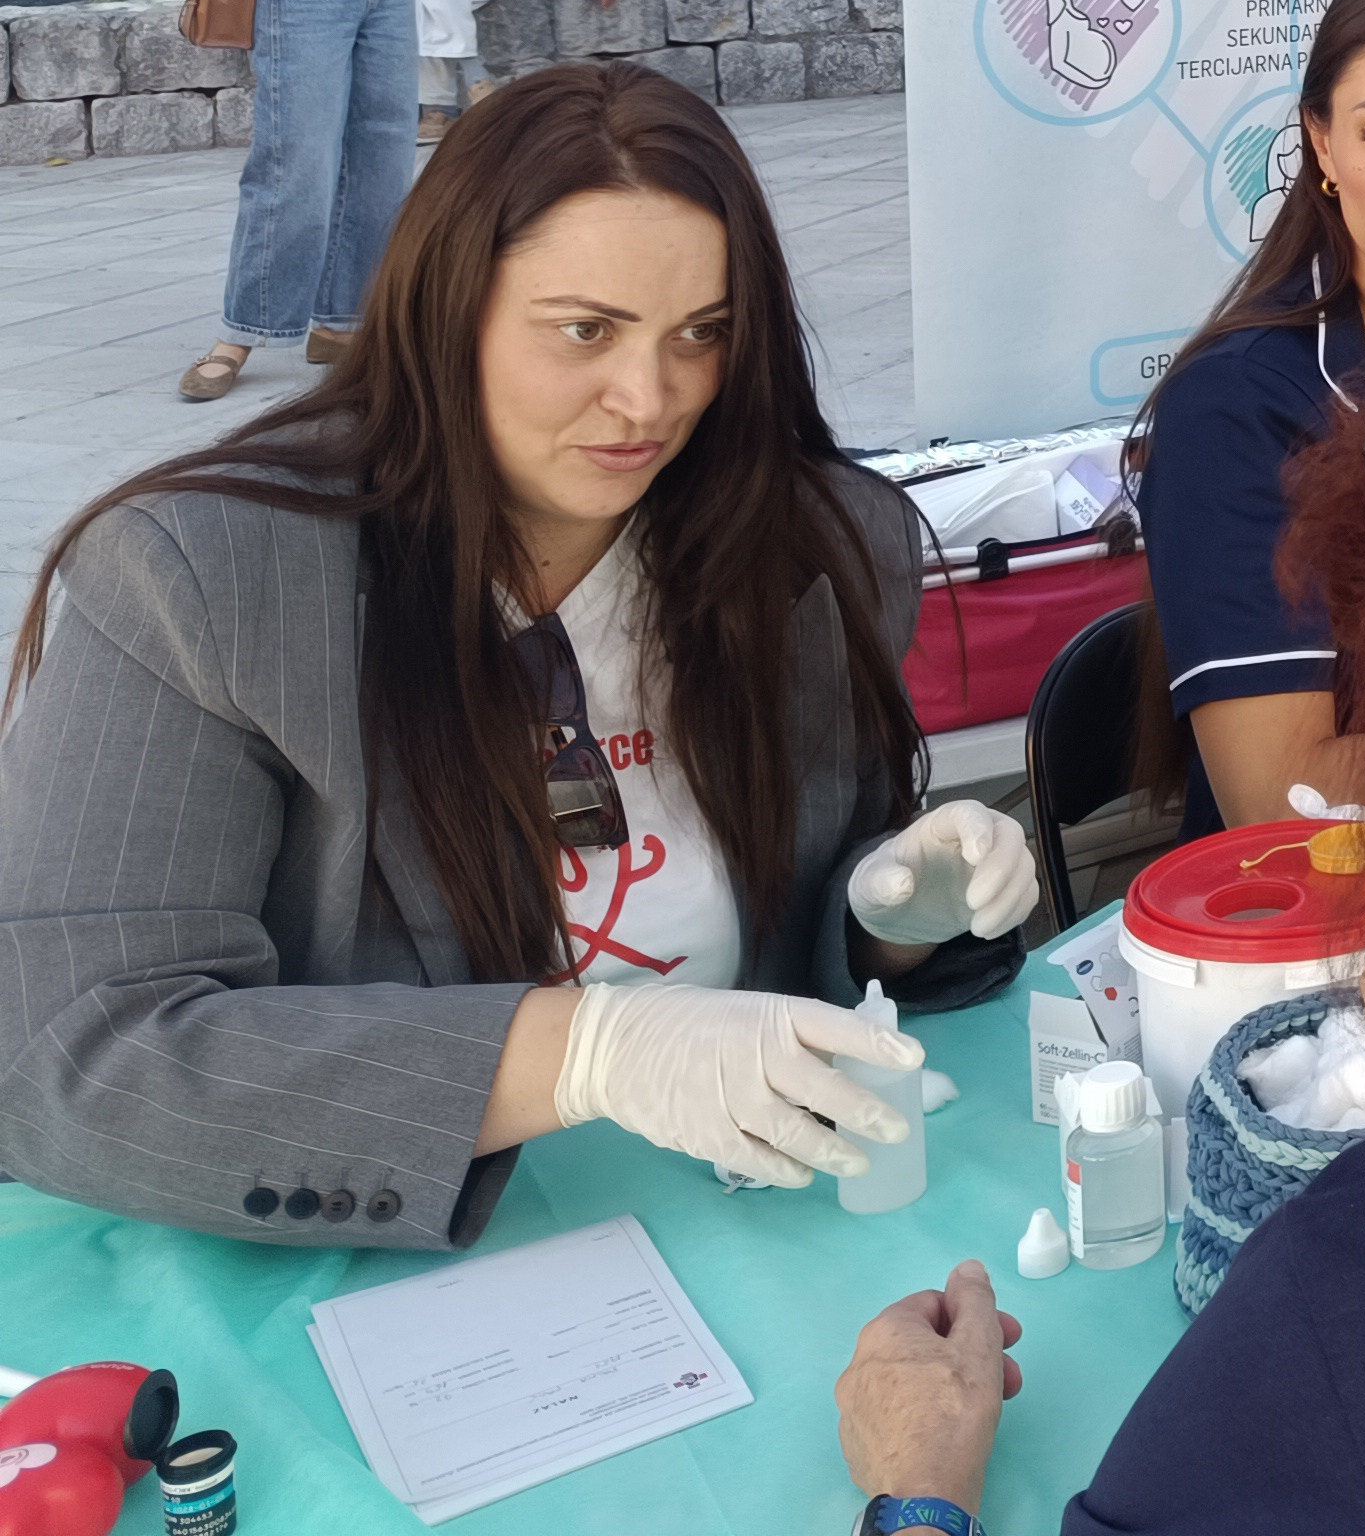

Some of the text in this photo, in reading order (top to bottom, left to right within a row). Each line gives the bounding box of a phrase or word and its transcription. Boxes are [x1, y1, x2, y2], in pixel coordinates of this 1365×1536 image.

[1176, 52, 1312, 80] TERCIJARNA P
[1141, 352, 1179, 379] GR
